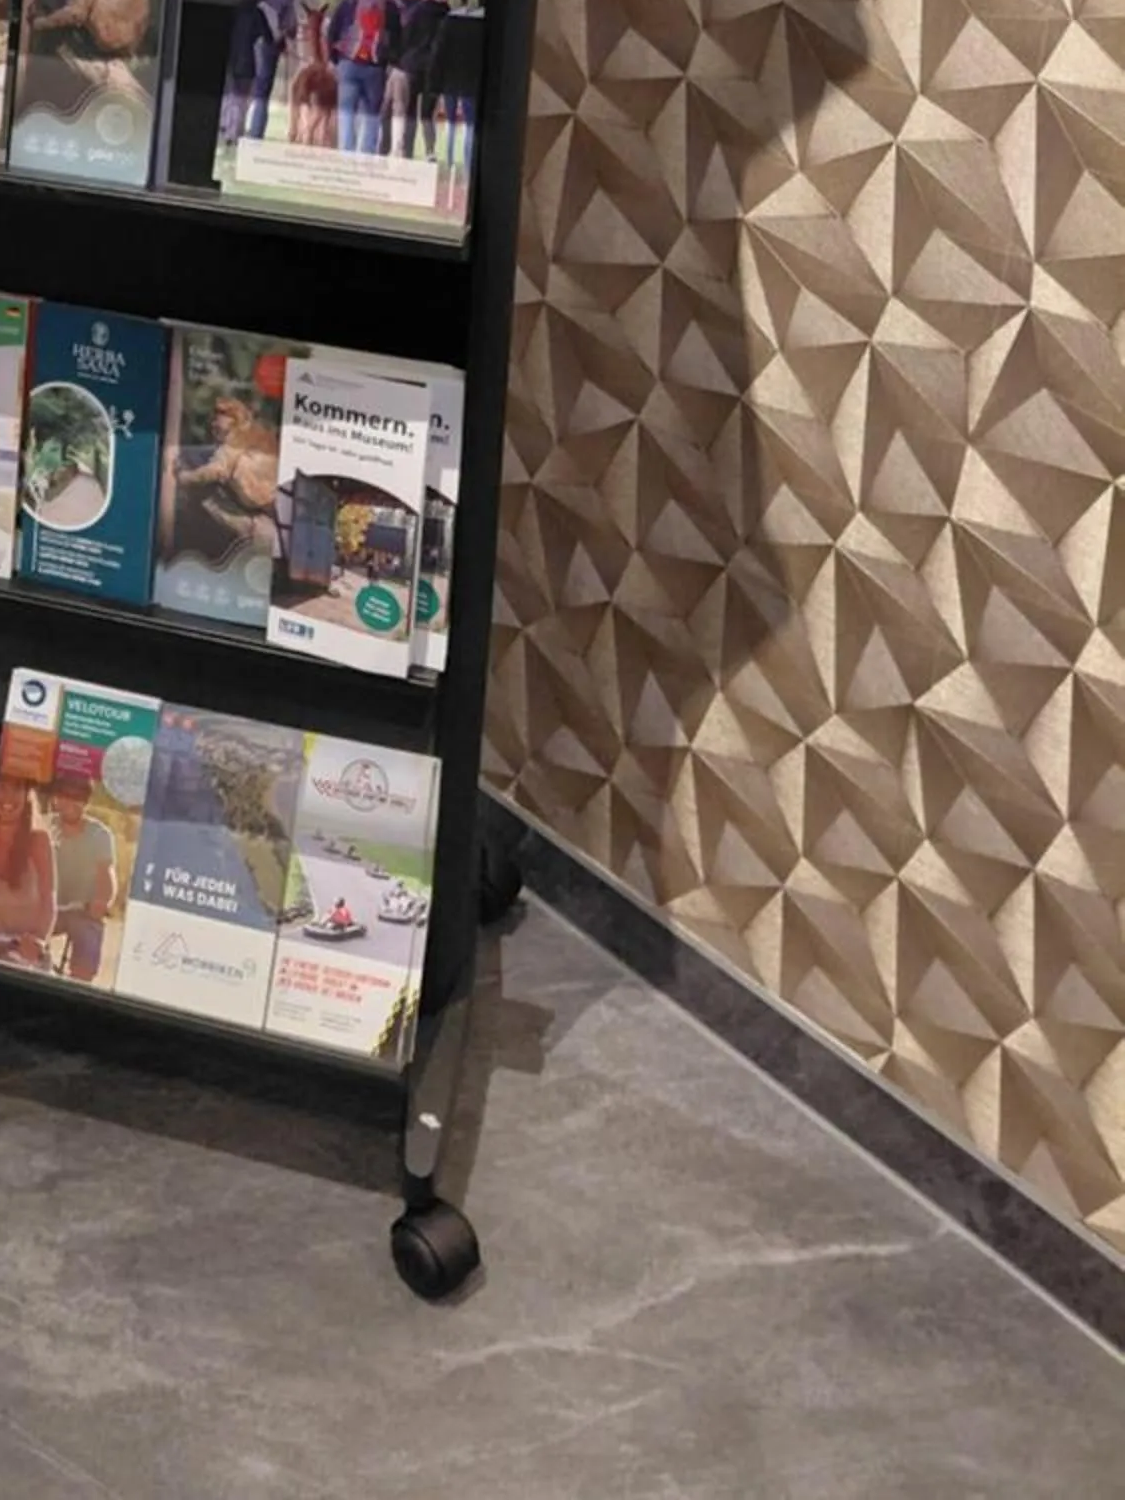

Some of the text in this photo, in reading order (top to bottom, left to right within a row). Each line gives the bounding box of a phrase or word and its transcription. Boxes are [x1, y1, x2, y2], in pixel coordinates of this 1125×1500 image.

[294, 392, 415, 438] Kommern.
[327, 426, 348, 439] ins
[350, 430, 414, 454] Museum!
[66, 697, 132, 722] VELOTOUR
[165, 866, 192, 885] FÜR
[192, 875, 237, 897] JEDEN
[162, 883, 239, 914] WAS DABEI
